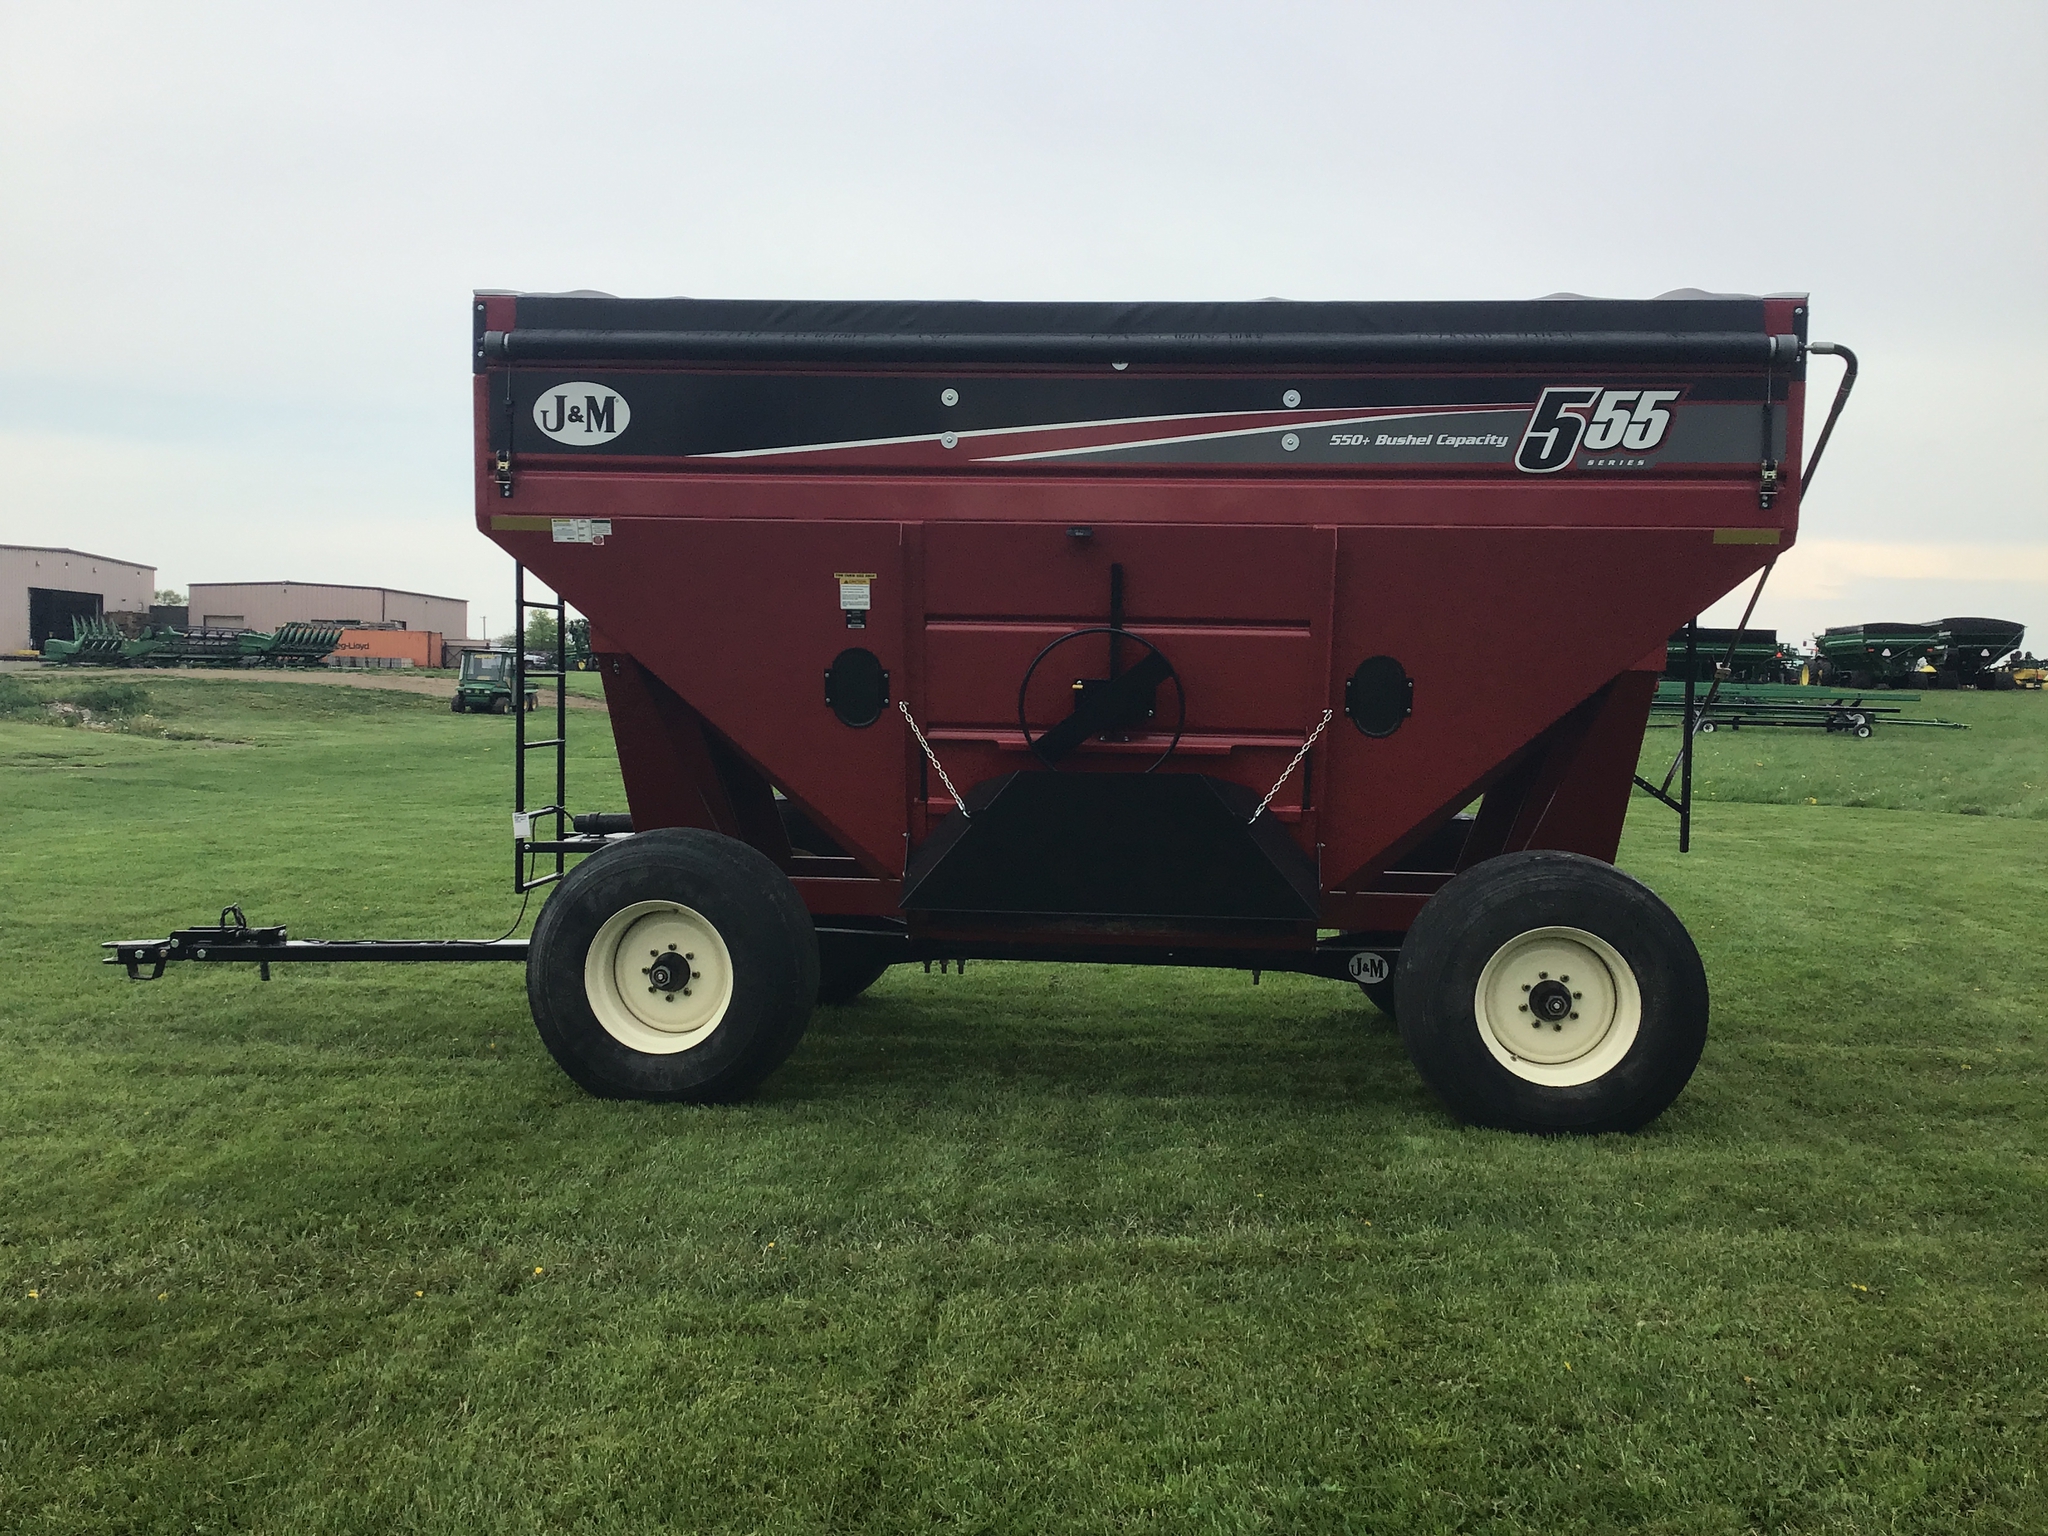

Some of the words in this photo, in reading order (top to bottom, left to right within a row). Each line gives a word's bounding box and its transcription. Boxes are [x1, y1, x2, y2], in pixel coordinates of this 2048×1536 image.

[540, 395, 618, 434] J&M
[1329, 434, 1371, 446] 550+
[1374, 434, 1433, 446] Bushel
[1436, 434, 1509, 448] Capacity
[1514, 386, 1681, 474] 555
[1587, 459, 1646, 467] SERIES
[1350, 957, 1385, 979] J&M
